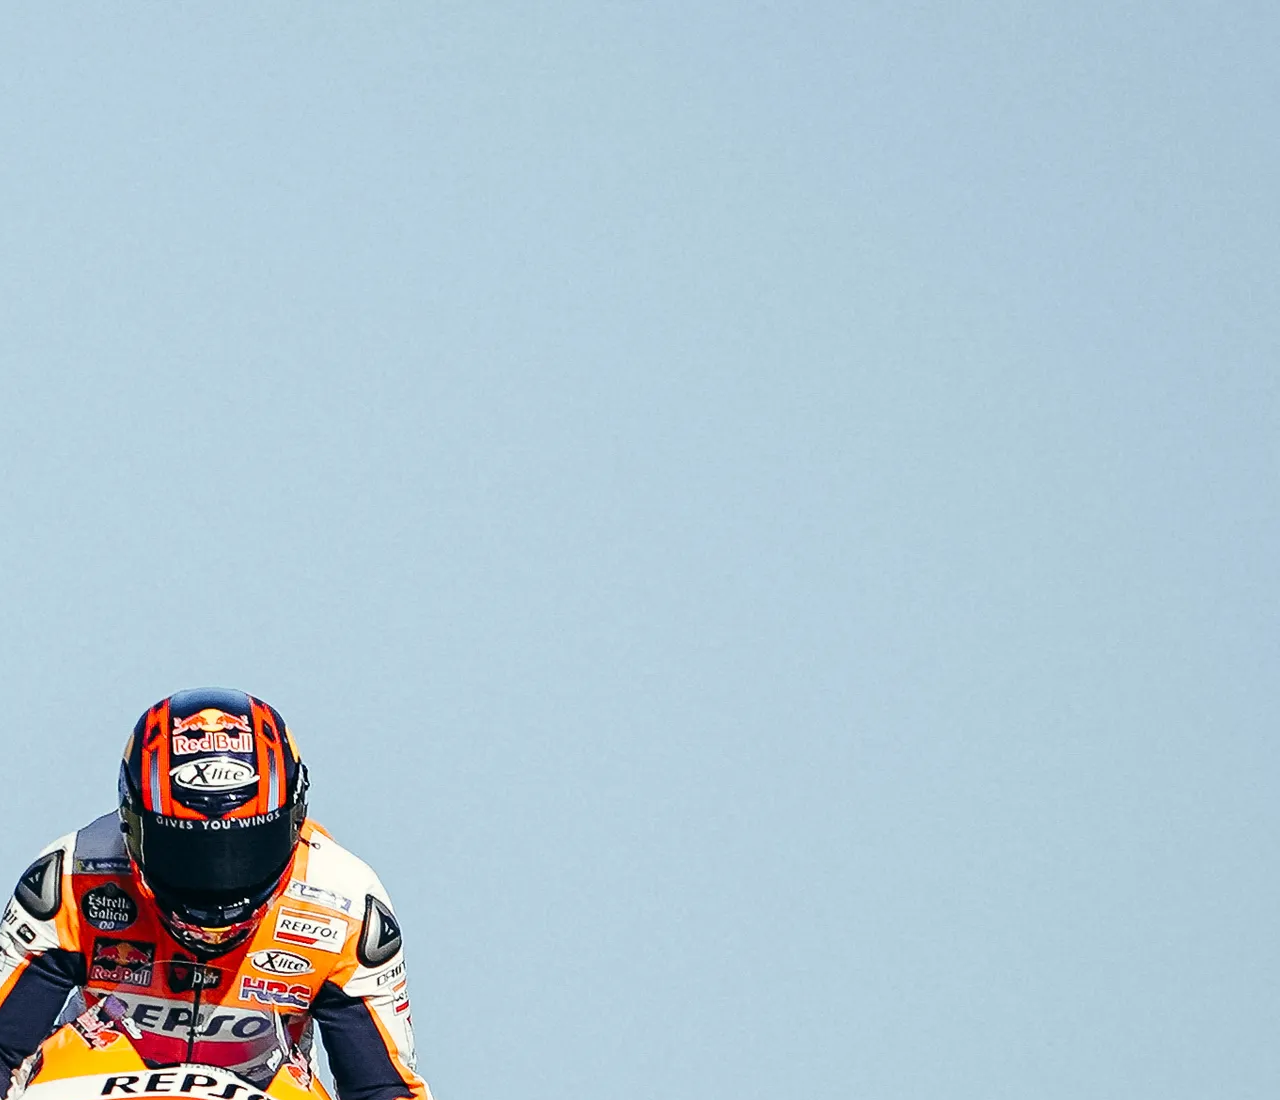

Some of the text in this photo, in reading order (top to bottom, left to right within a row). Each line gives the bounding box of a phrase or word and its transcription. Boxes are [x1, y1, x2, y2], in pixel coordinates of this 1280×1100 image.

[172, 731, 253, 755] Red Bull
[190, 763, 244, 784] X-lite
[156, 810, 280, 830] GIVES YOU WINGS
[88, 905, 129, 922] Galicia
[280, 918, 338, 940] REPSOL
[89, 964, 152, 986] Red Bull
[102, 993, 272, 1039] EPSO
